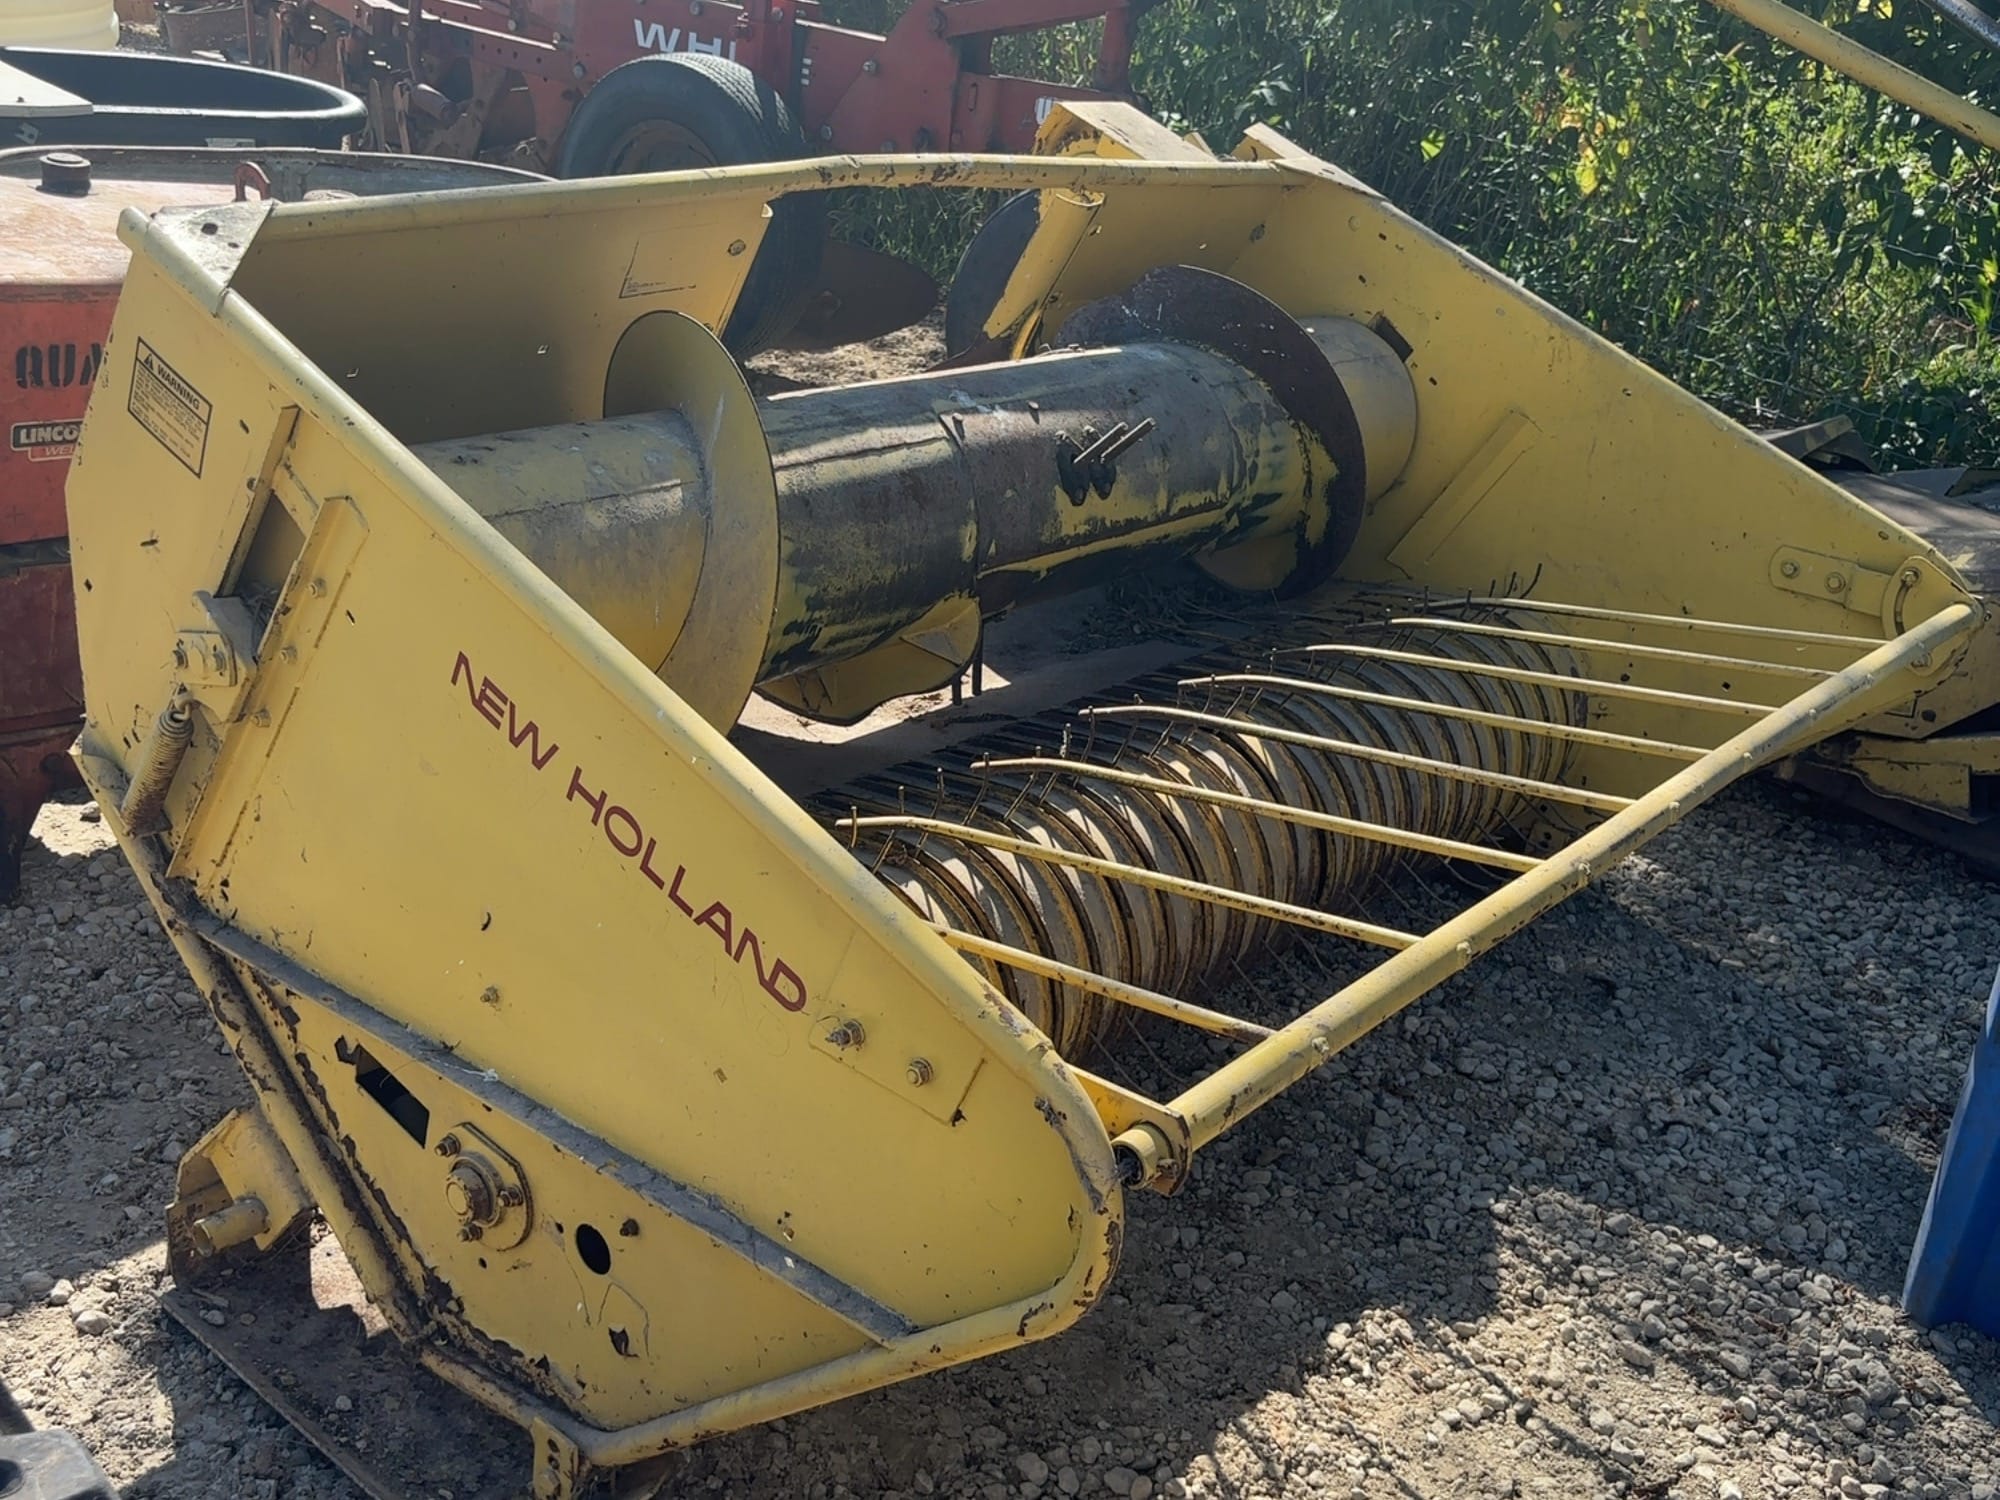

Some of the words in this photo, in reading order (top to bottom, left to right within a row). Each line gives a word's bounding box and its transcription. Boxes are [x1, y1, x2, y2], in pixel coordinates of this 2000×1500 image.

[157, 363, 200, 411] WARNING
[451, 650, 560, 771] NEW
[566, 765, 807, 1013] HOLLAND
